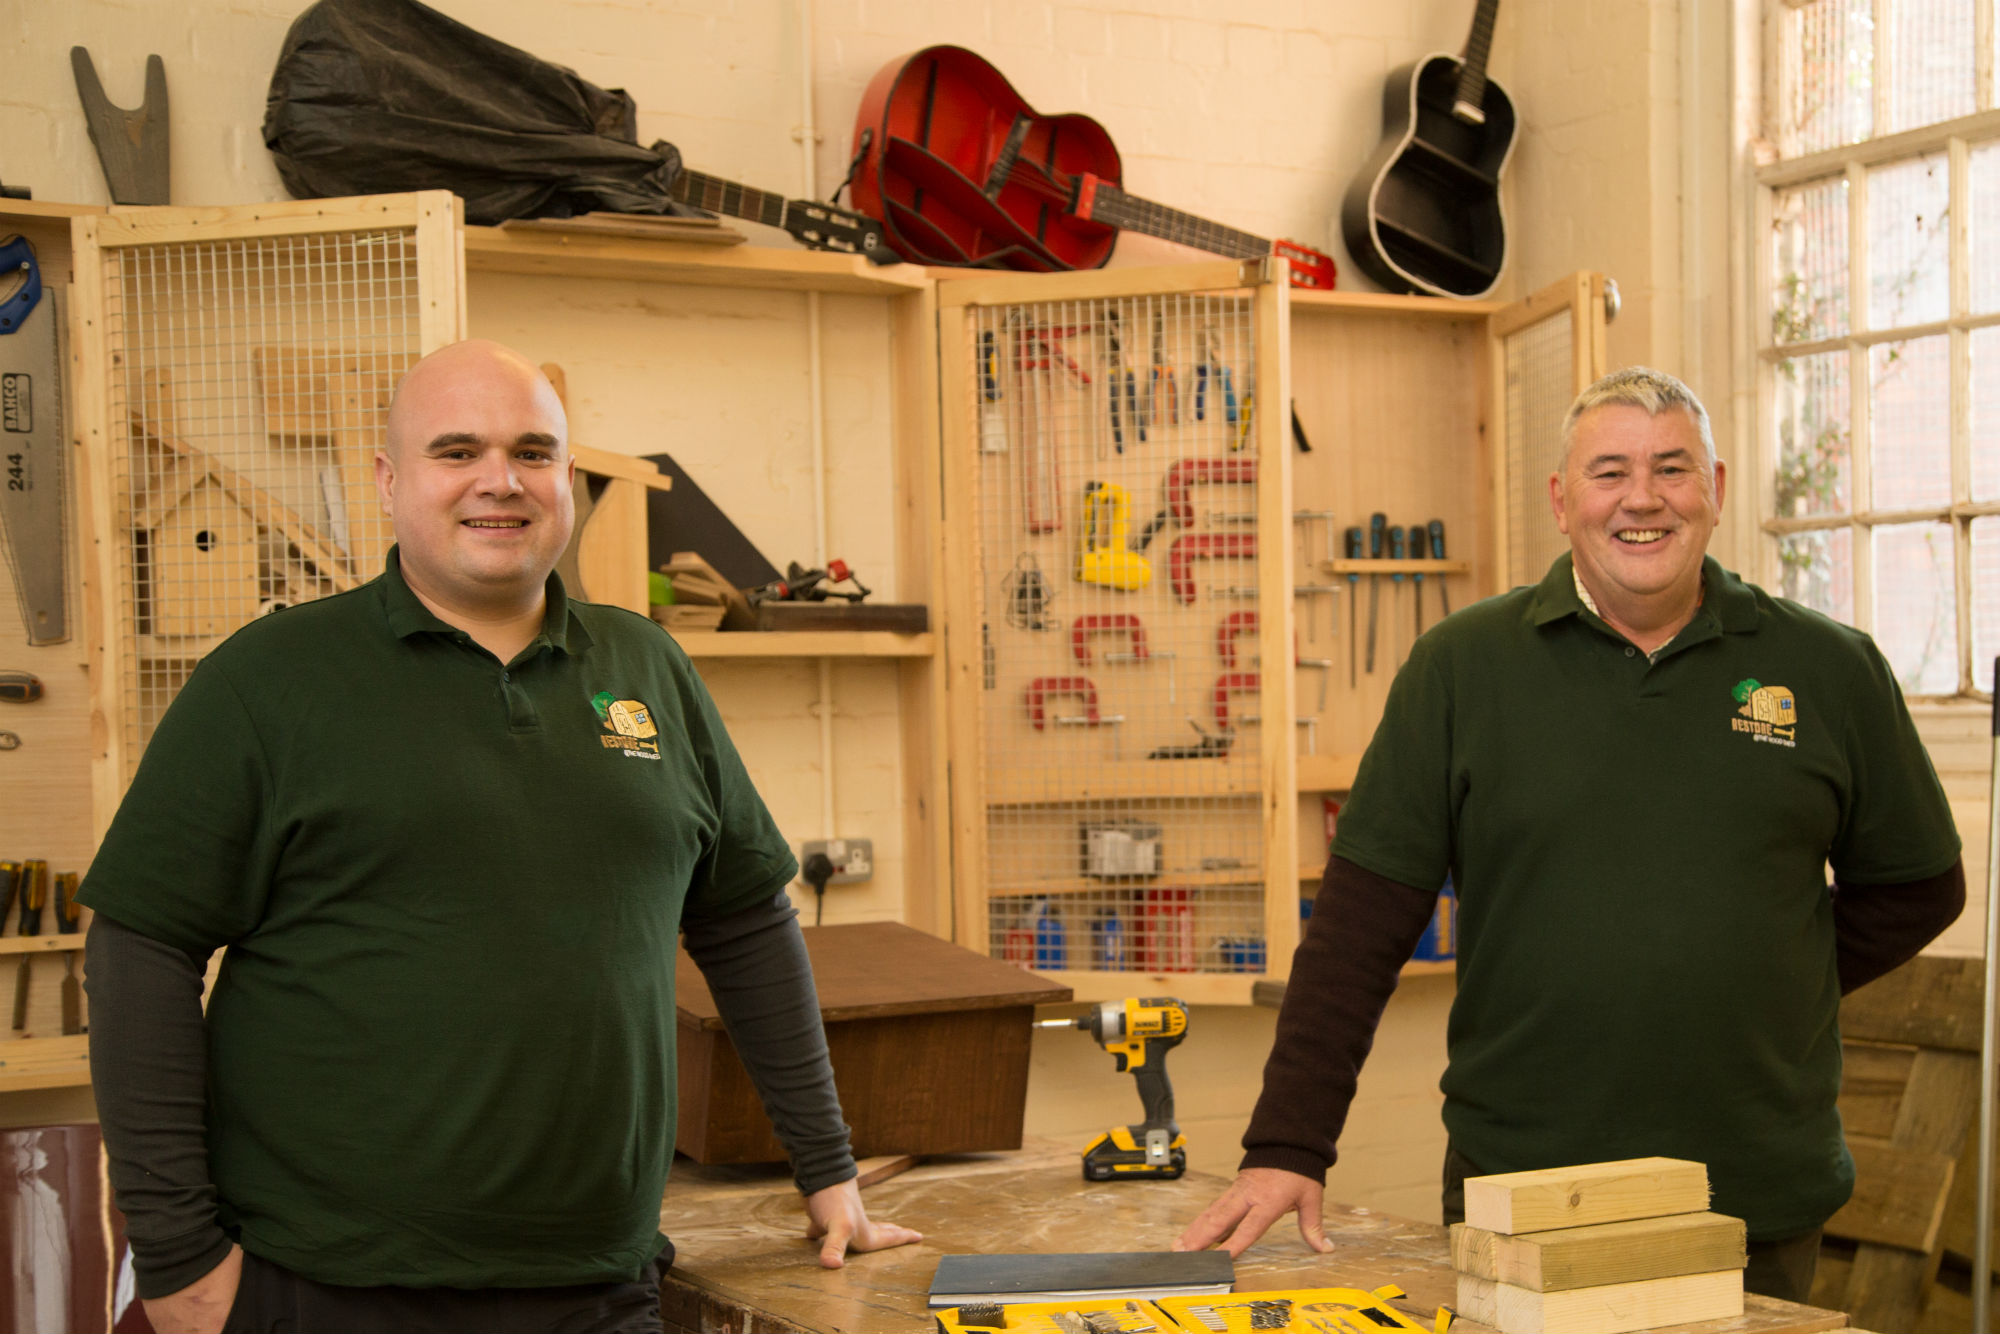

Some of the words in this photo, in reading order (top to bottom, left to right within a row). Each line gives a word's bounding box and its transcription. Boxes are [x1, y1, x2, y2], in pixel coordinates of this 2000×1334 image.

[3, 375, 18, 430] BAHCO
[7, 453, 23, 491] 244
[1731, 717, 1773, 737] RESTORE
